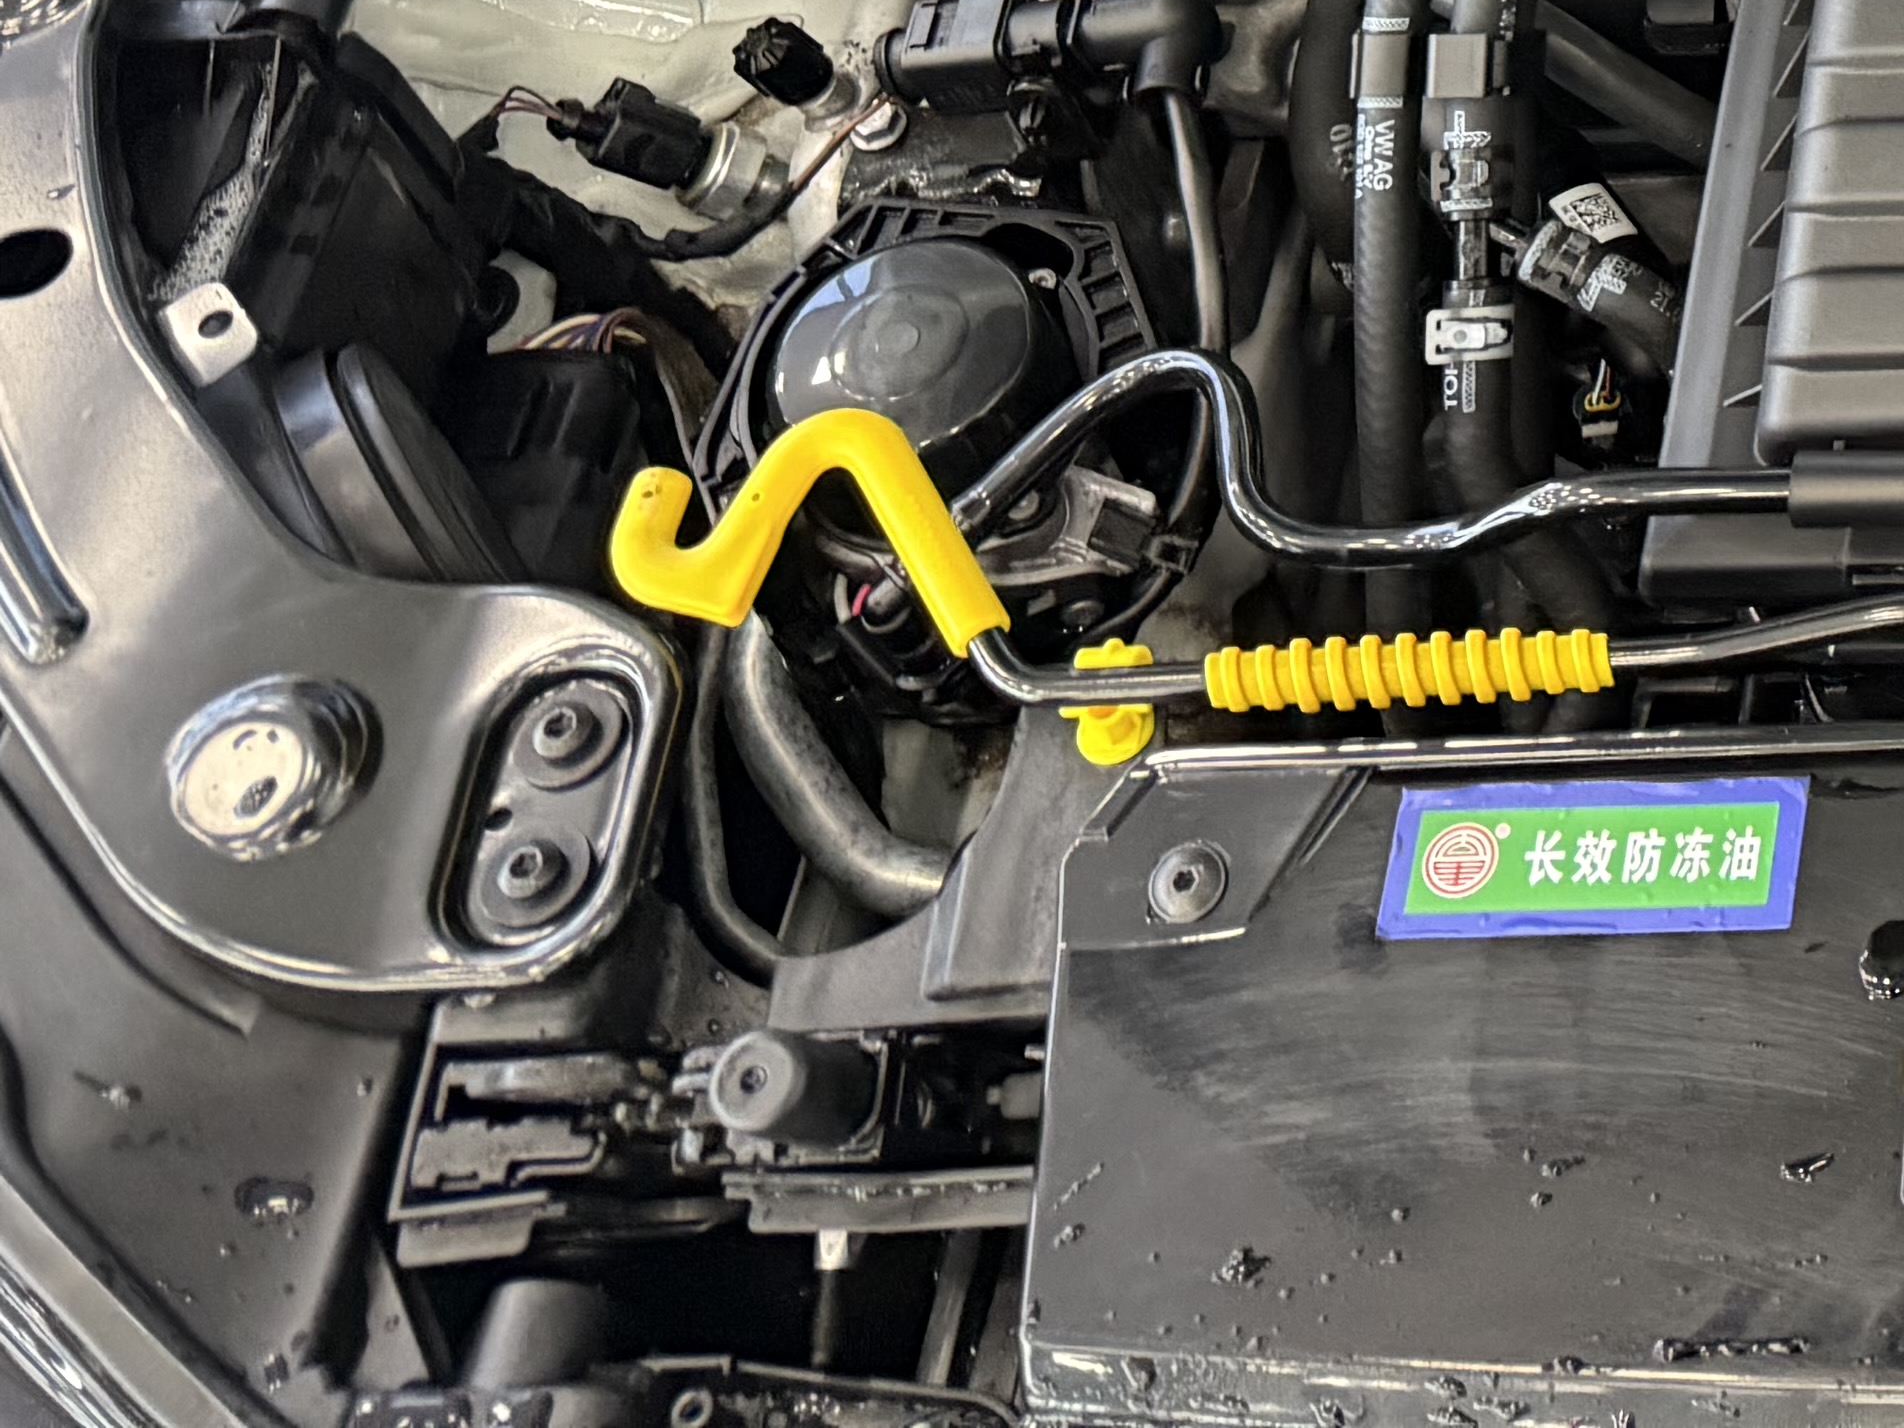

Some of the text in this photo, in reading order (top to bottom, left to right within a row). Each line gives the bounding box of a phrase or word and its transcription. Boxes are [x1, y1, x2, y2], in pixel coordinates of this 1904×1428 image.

[1373, 158, 1394, 191] AG
[1524, 825, 1762, 887] 长效防冻油
